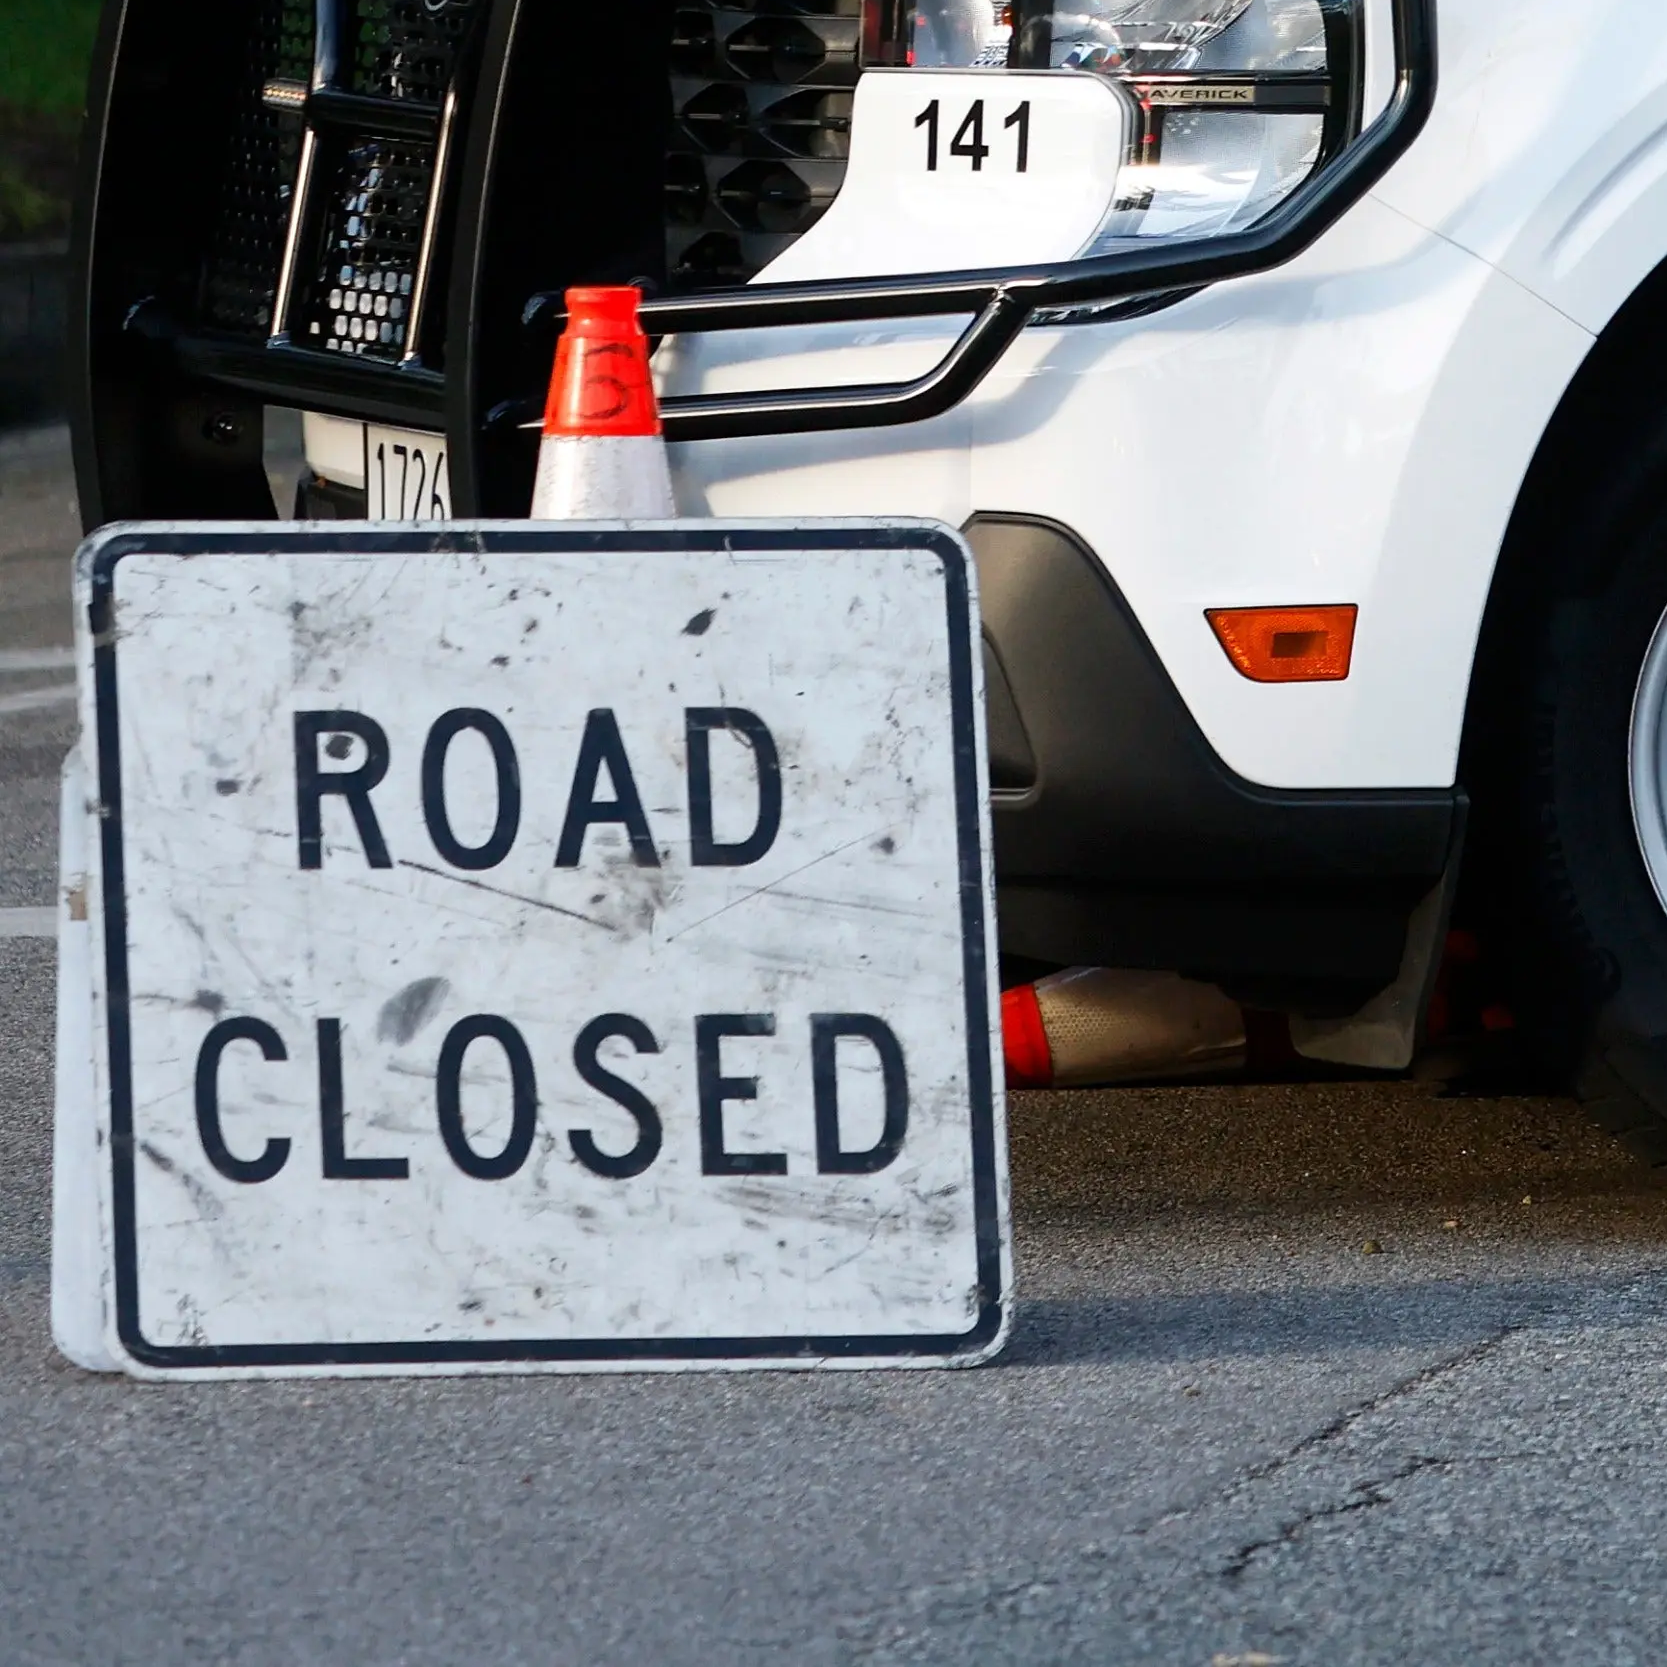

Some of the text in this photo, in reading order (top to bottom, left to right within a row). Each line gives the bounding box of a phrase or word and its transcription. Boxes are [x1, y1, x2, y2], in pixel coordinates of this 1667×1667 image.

[1150, 88, 1248, 101] AVERICK
[914, 99, 1032, 174] 141
[377, 442, 446, 520] 1726
[292, 706, 784, 871] ROAD
[192, 1012, 910, 1185] CLOSED
